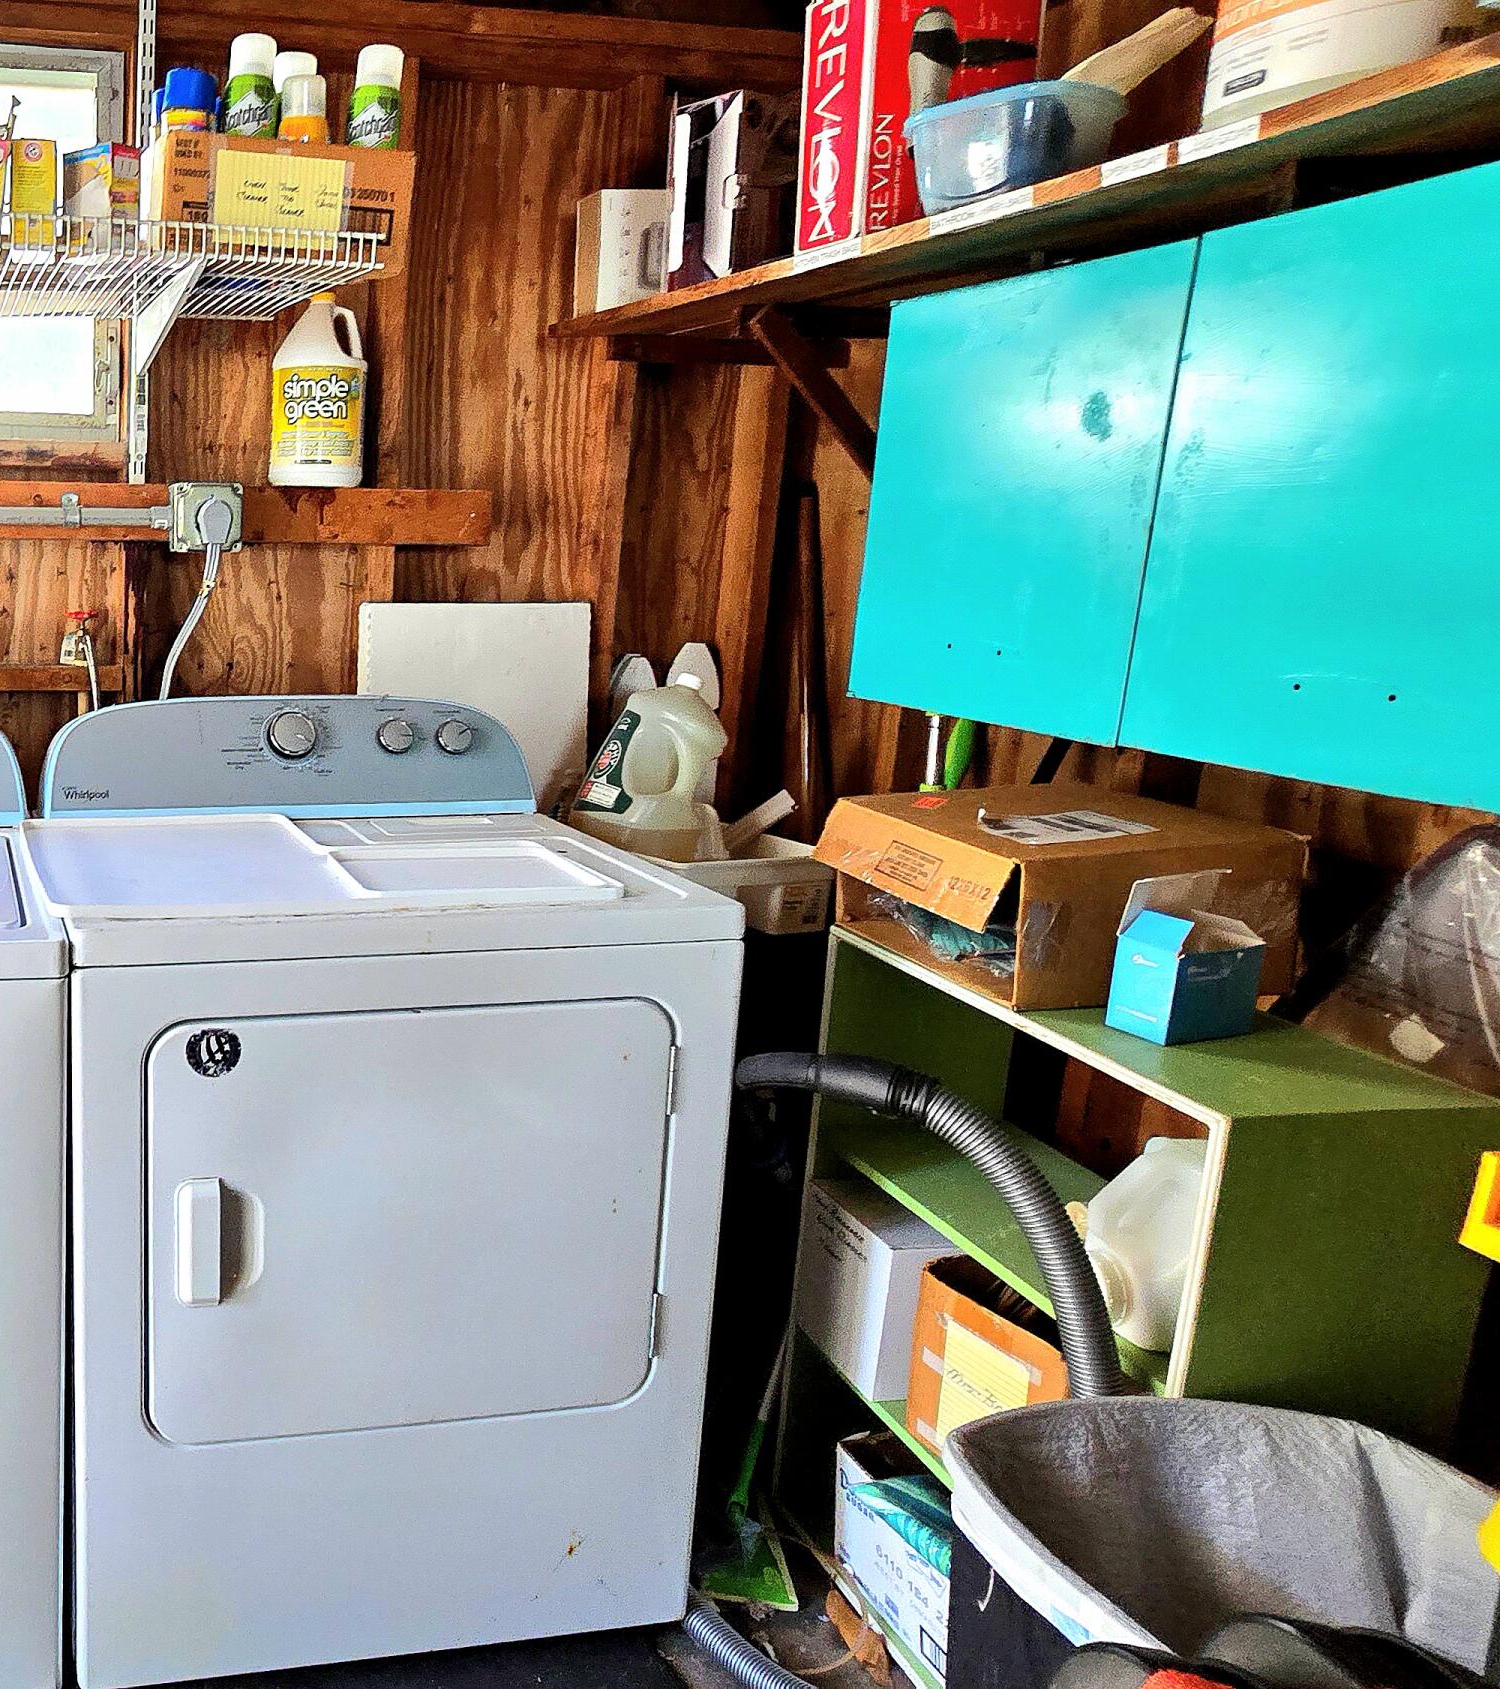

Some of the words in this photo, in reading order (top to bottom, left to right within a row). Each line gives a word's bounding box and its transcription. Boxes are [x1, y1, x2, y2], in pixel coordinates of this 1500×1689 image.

[808, 0, 850, 242] REVLON
[869, 114, 895, 230] REVLON
[283, 373, 349, 403] simple
[284, 399, 348, 425] green
[63, 789, 110, 801] Whirlpool
